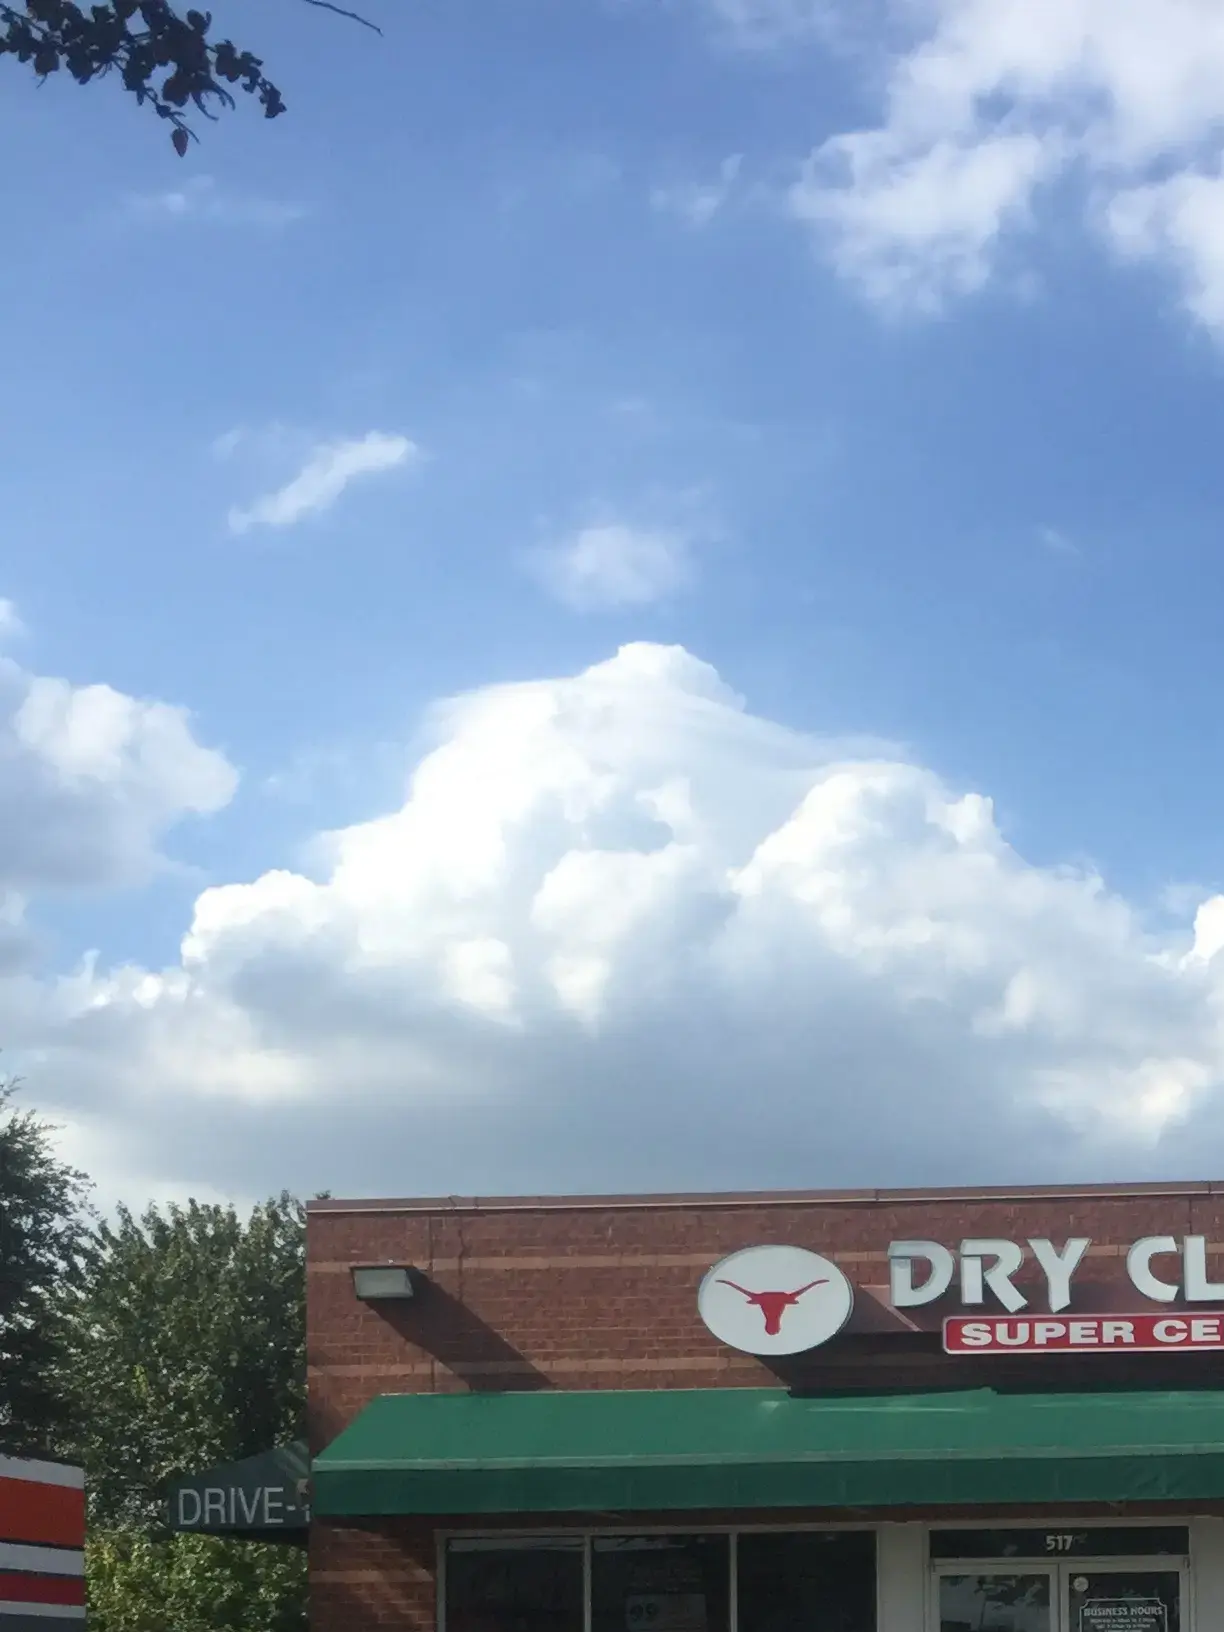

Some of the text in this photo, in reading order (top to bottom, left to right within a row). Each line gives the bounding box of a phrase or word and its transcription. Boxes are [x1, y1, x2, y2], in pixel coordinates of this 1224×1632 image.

[887, 1238, 1092, 1314] DRY
[960, 1321, 1135, 1346] SUPER
[1046, 1535, 1074, 1551] 517
[1084, 1606, 1164, 1616] BUSINESS HOURS
